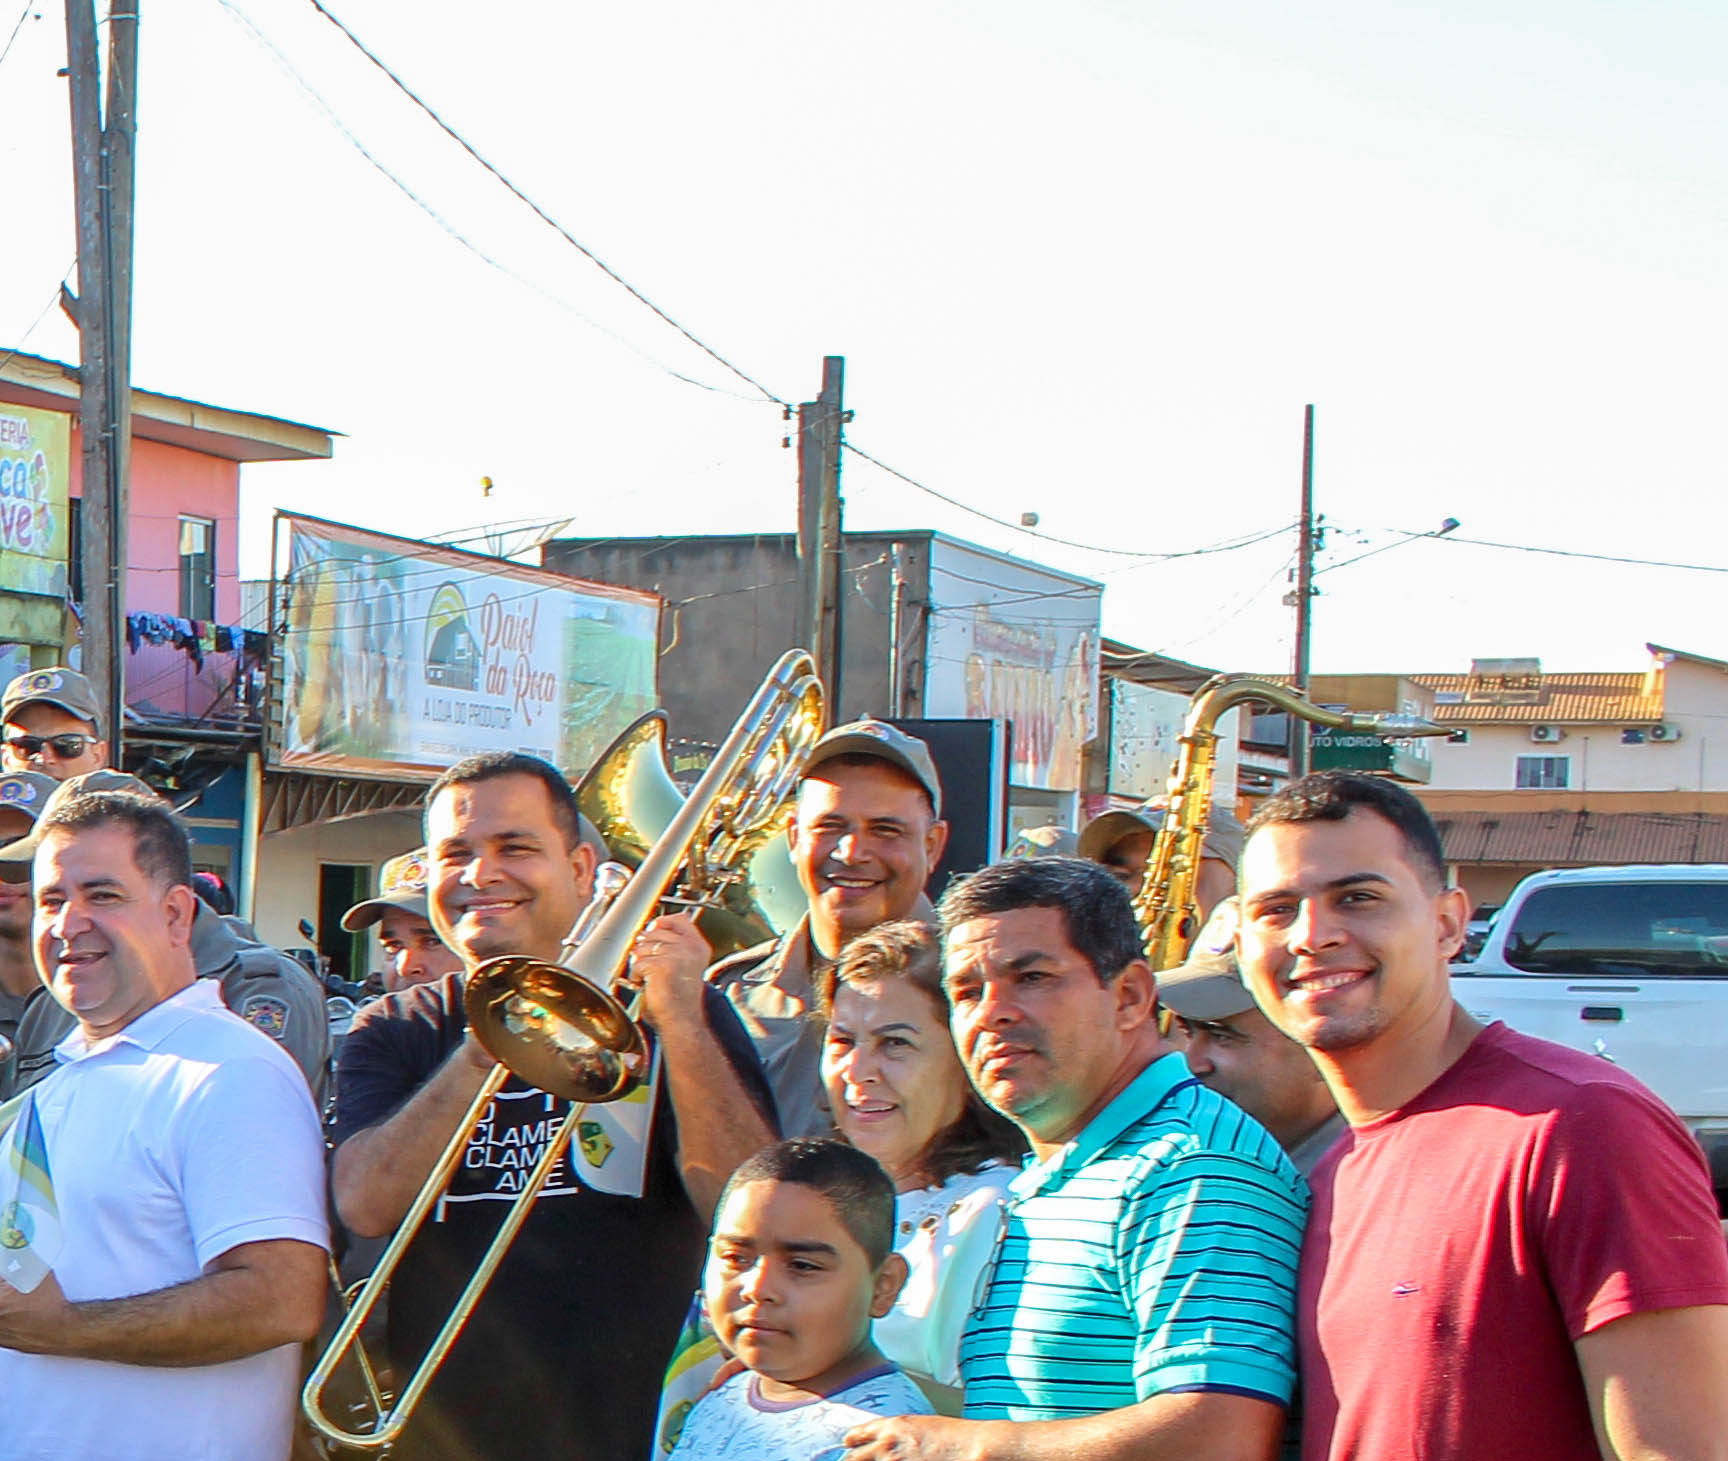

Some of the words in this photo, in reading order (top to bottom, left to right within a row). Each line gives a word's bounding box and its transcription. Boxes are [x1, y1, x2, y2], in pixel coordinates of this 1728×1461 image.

[480, 592, 539, 665] Paiol
[423, 698, 431, 721] A
[486, 647, 508, 697] da
[513, 653, 556, 727] Roça
